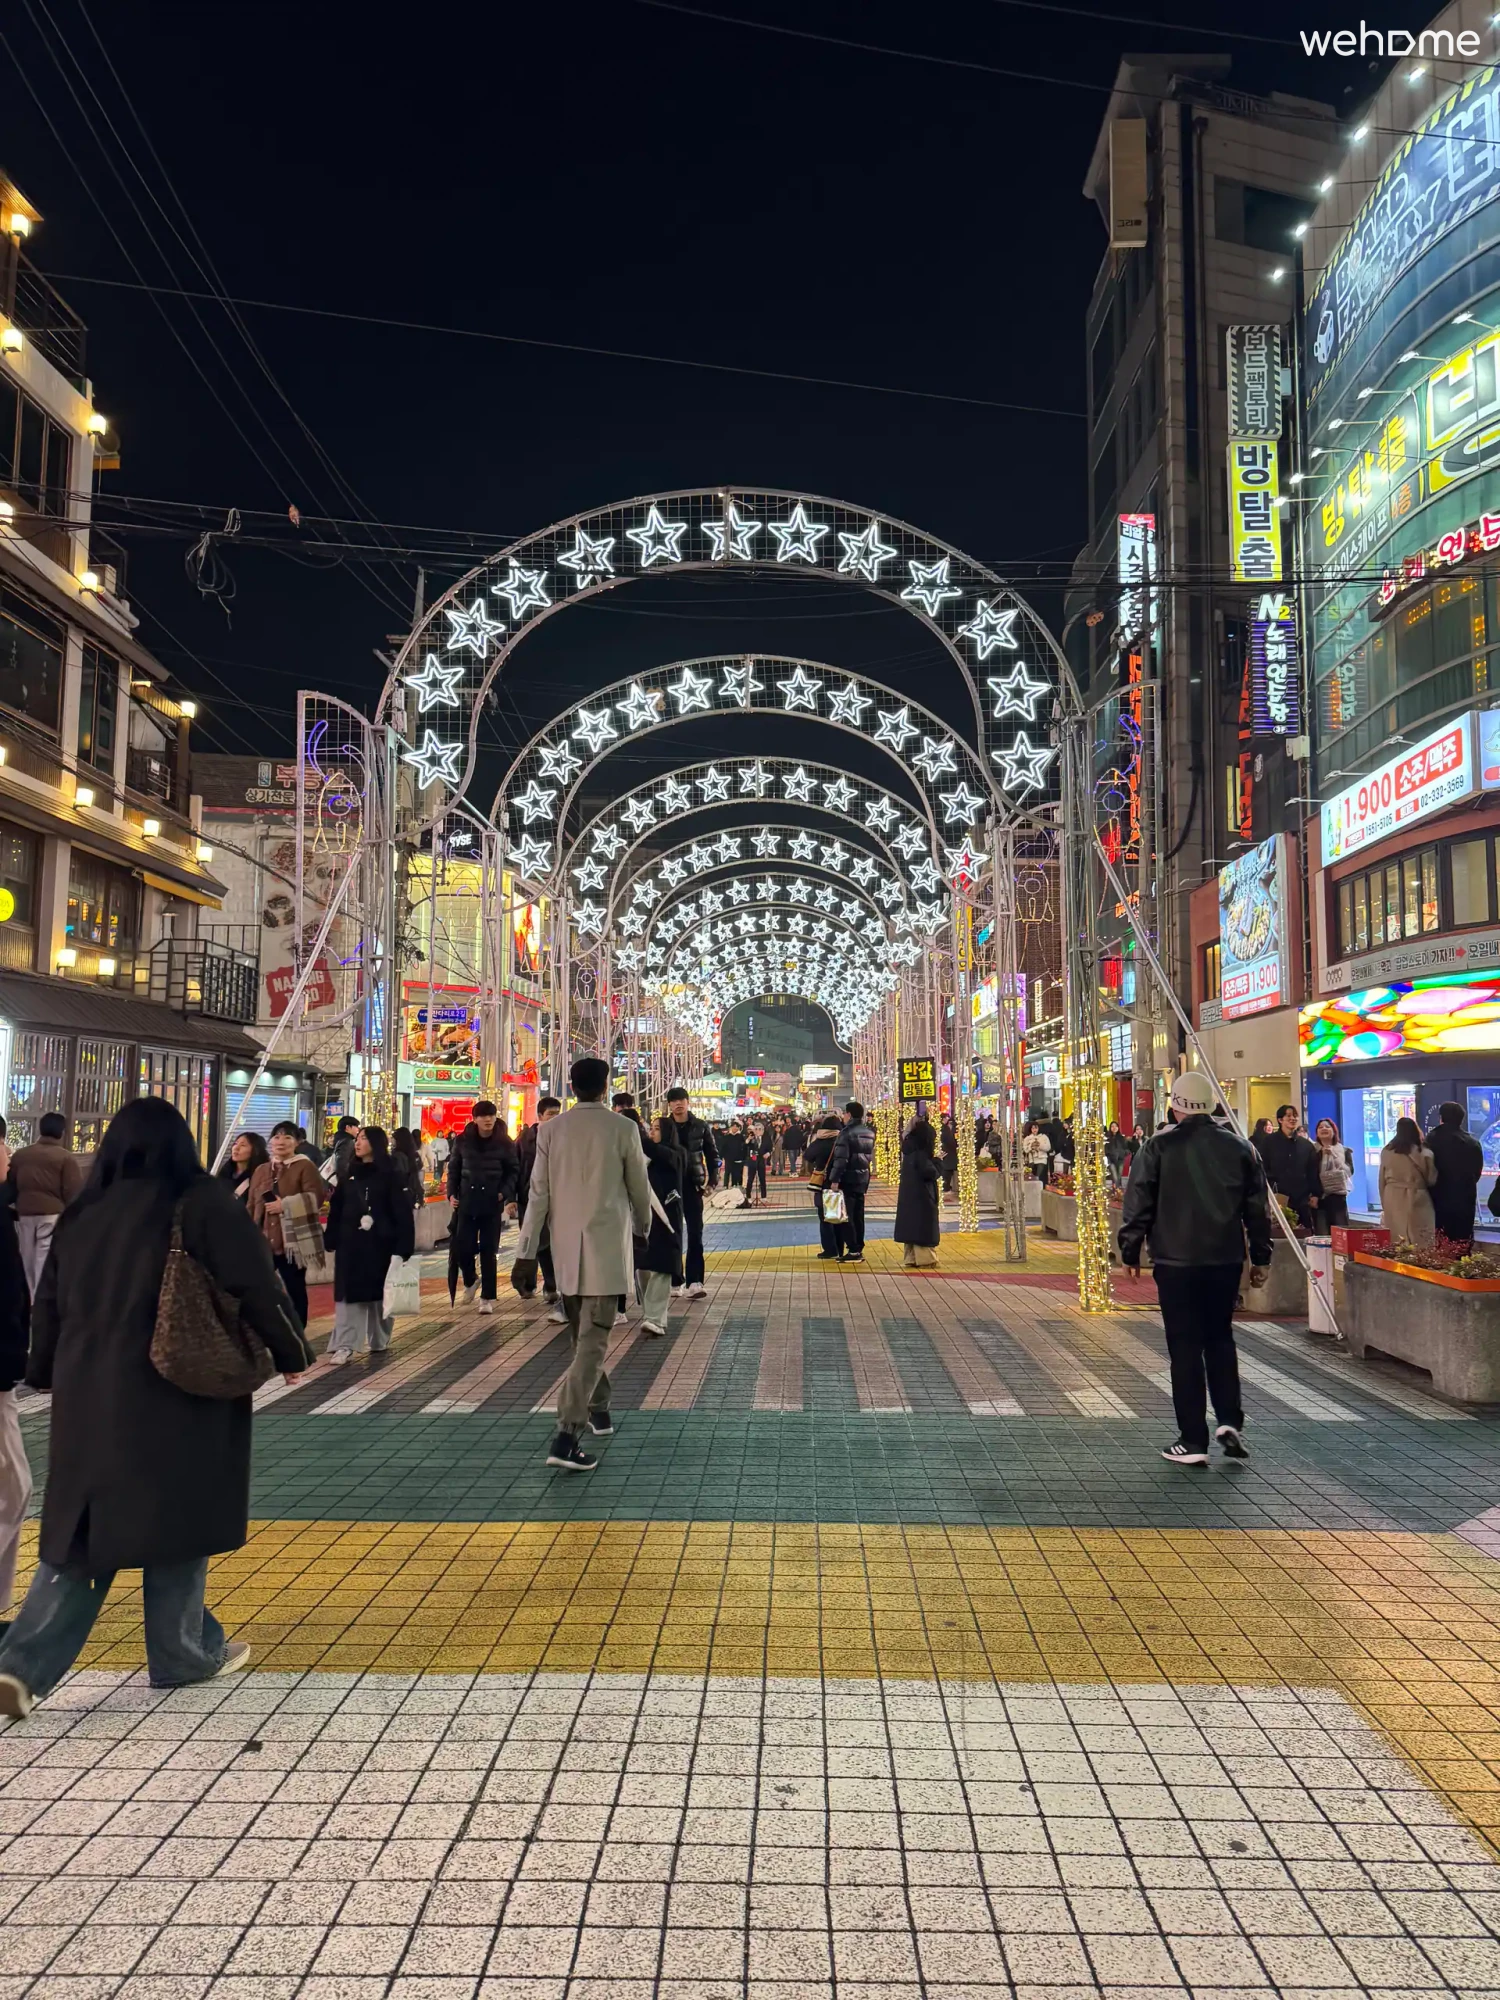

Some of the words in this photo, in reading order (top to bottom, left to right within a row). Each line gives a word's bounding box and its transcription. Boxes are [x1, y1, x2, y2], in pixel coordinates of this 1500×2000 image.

[1243, 332, 1268, 428] 보드팩토리
[1236, 443, 1276, 579] 방탈출
[1344, 773, 1391, 828] 1,900
[1251, 962, 1277, 993] 1,900
[903, 1061, 933, 1081] 반값
[904, 1082, 933, 1097] 방탈출
